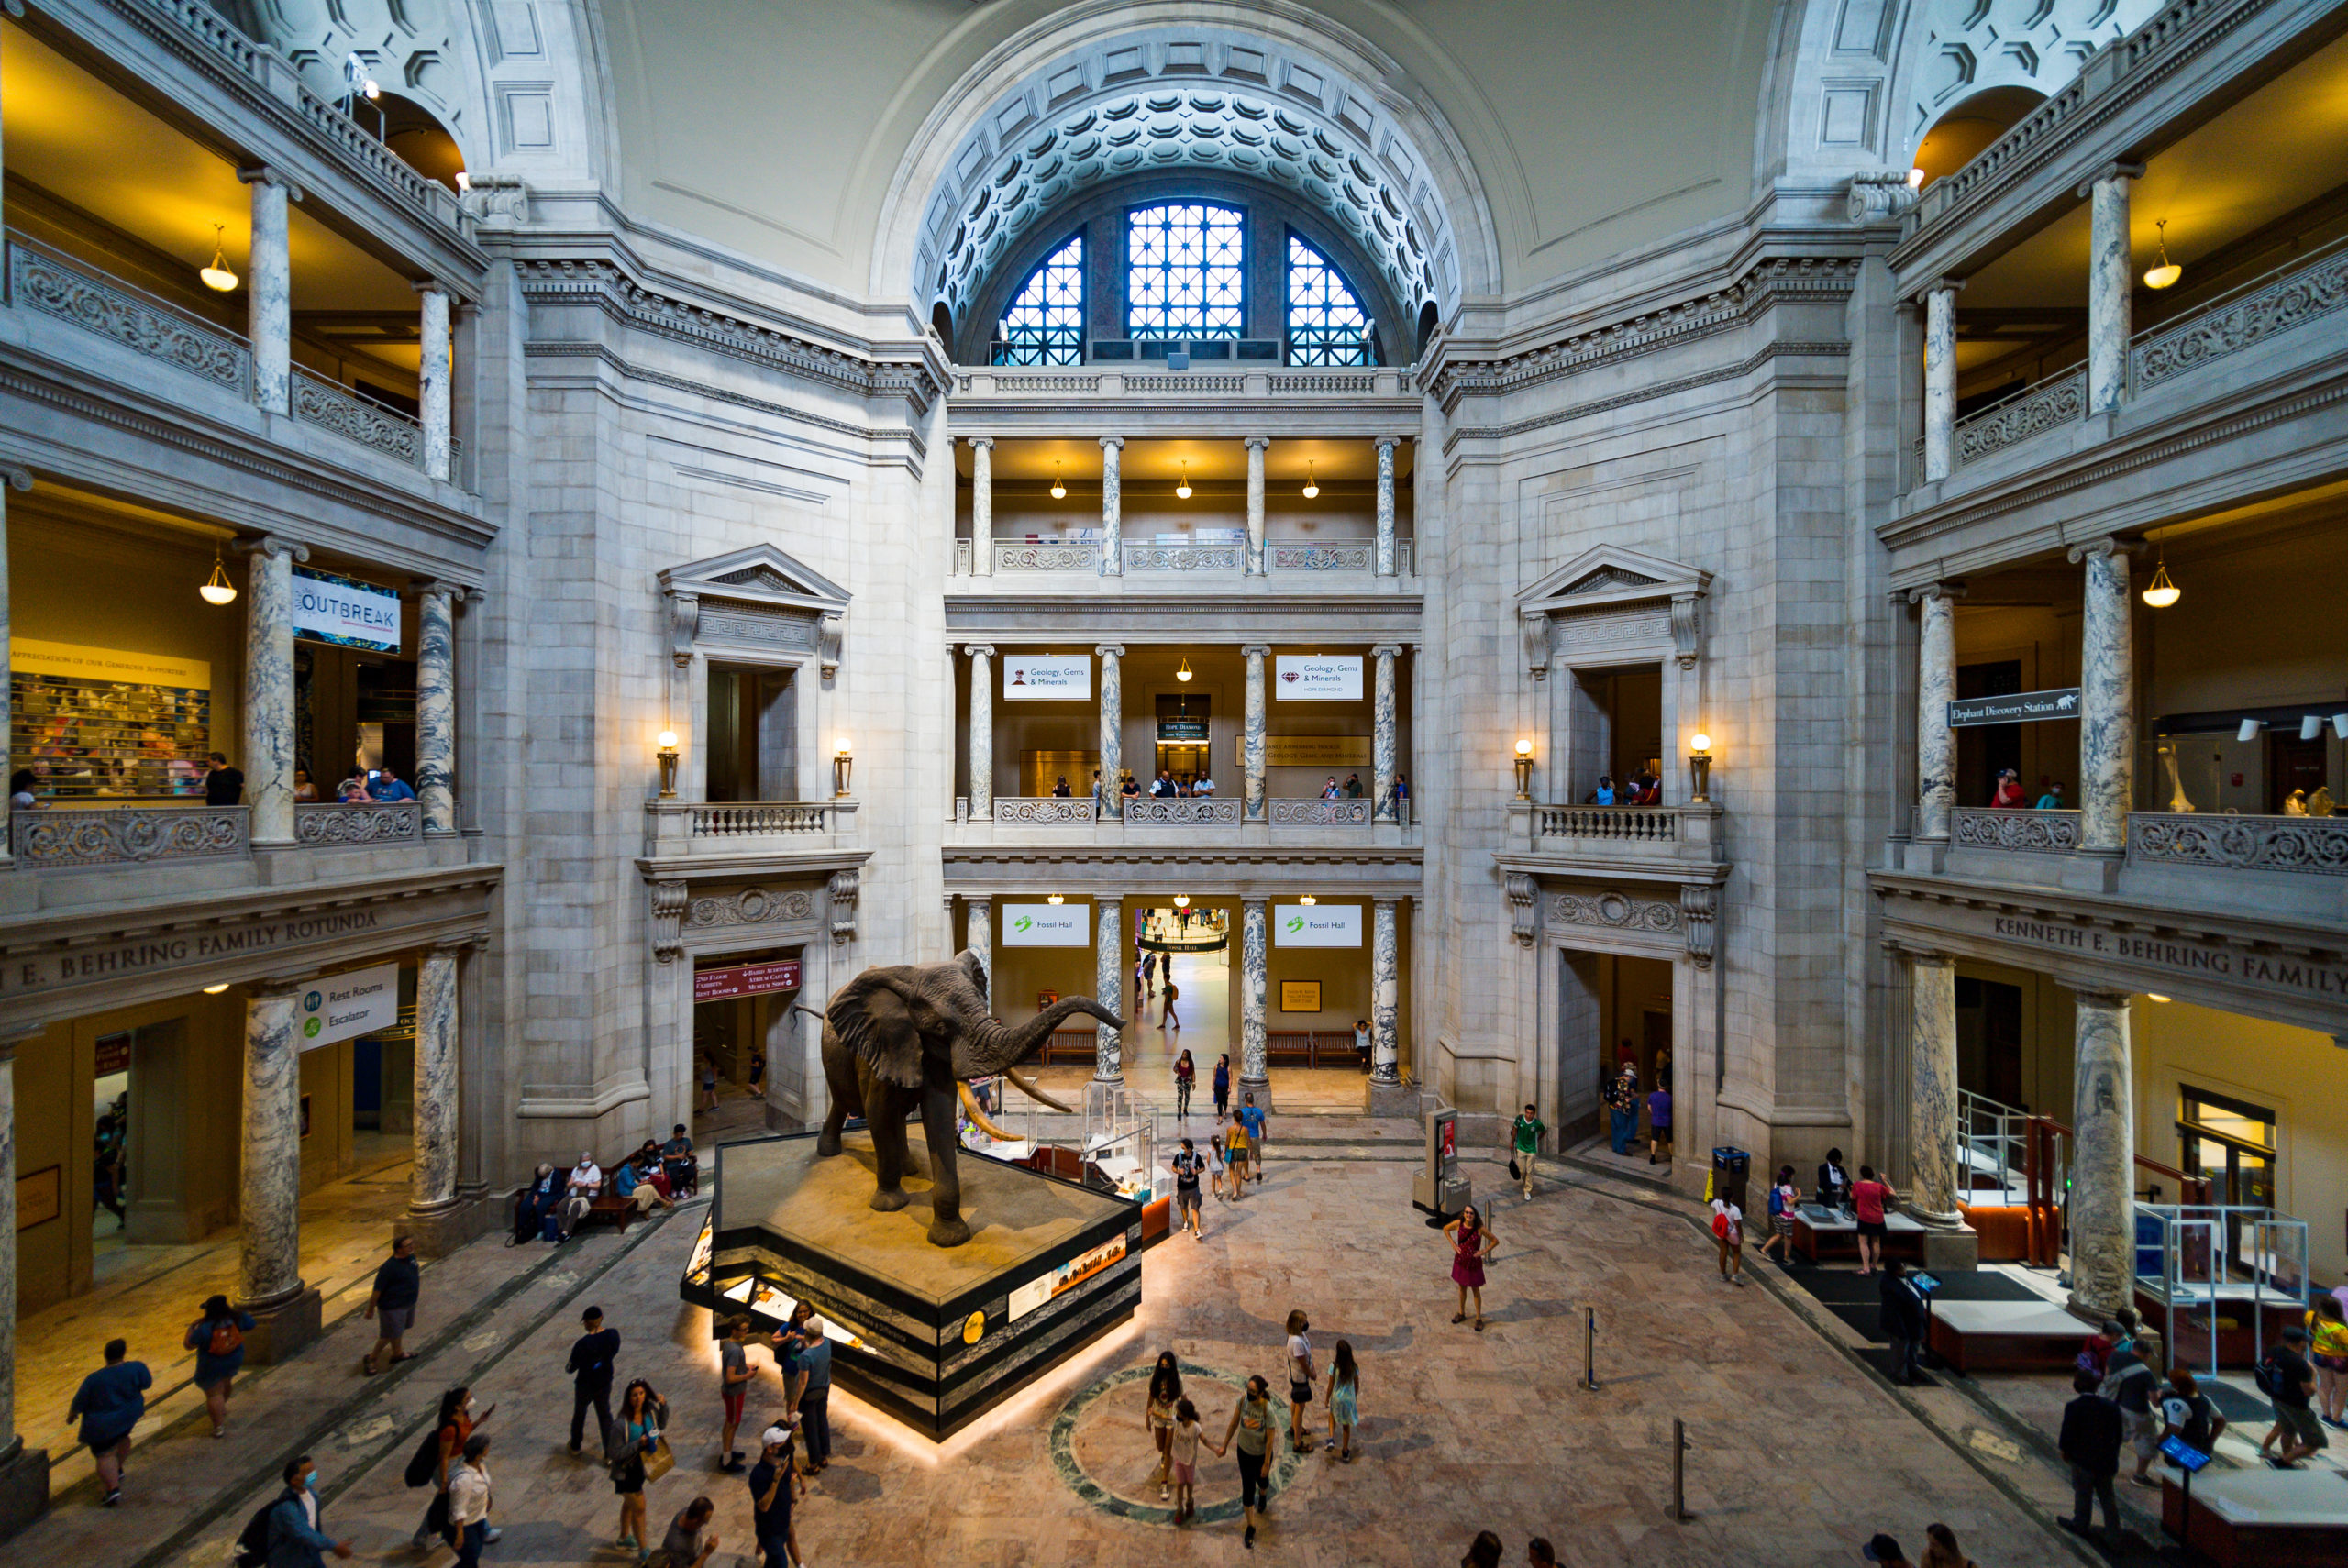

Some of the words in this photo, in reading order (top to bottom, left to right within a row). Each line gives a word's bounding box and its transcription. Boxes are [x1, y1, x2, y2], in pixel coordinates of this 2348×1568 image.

[302, 594, 393, 627] OUTBREAK
[1031, 668, 1062, 678] Geology,
[1304, 665, 1335, 673] Geology,
[1952, 708, 1983, 722] Elephant
[1985, 705, 2023, 718] Discovery
[2024, 701, 2054, 713] Station
[22, 963, 46, 985] E.
[61, 940, 188, 979] BEHRING
[198, 925, 277, 956] FAMILY
[285, 910, 378, 942] ROTUNDA
[1995, 917, 2084, 947] KENNETH
[2093, 933, 2110, 953] E.
[2118, 936, 2230, 974] BEHRING
[2243, 957, 2348, 994] FAMILY
[330, 991, 351, 1003] Rest
[353, 983, 383, 997] Rooms
[329, 1010, 371, 1027] Escalator
